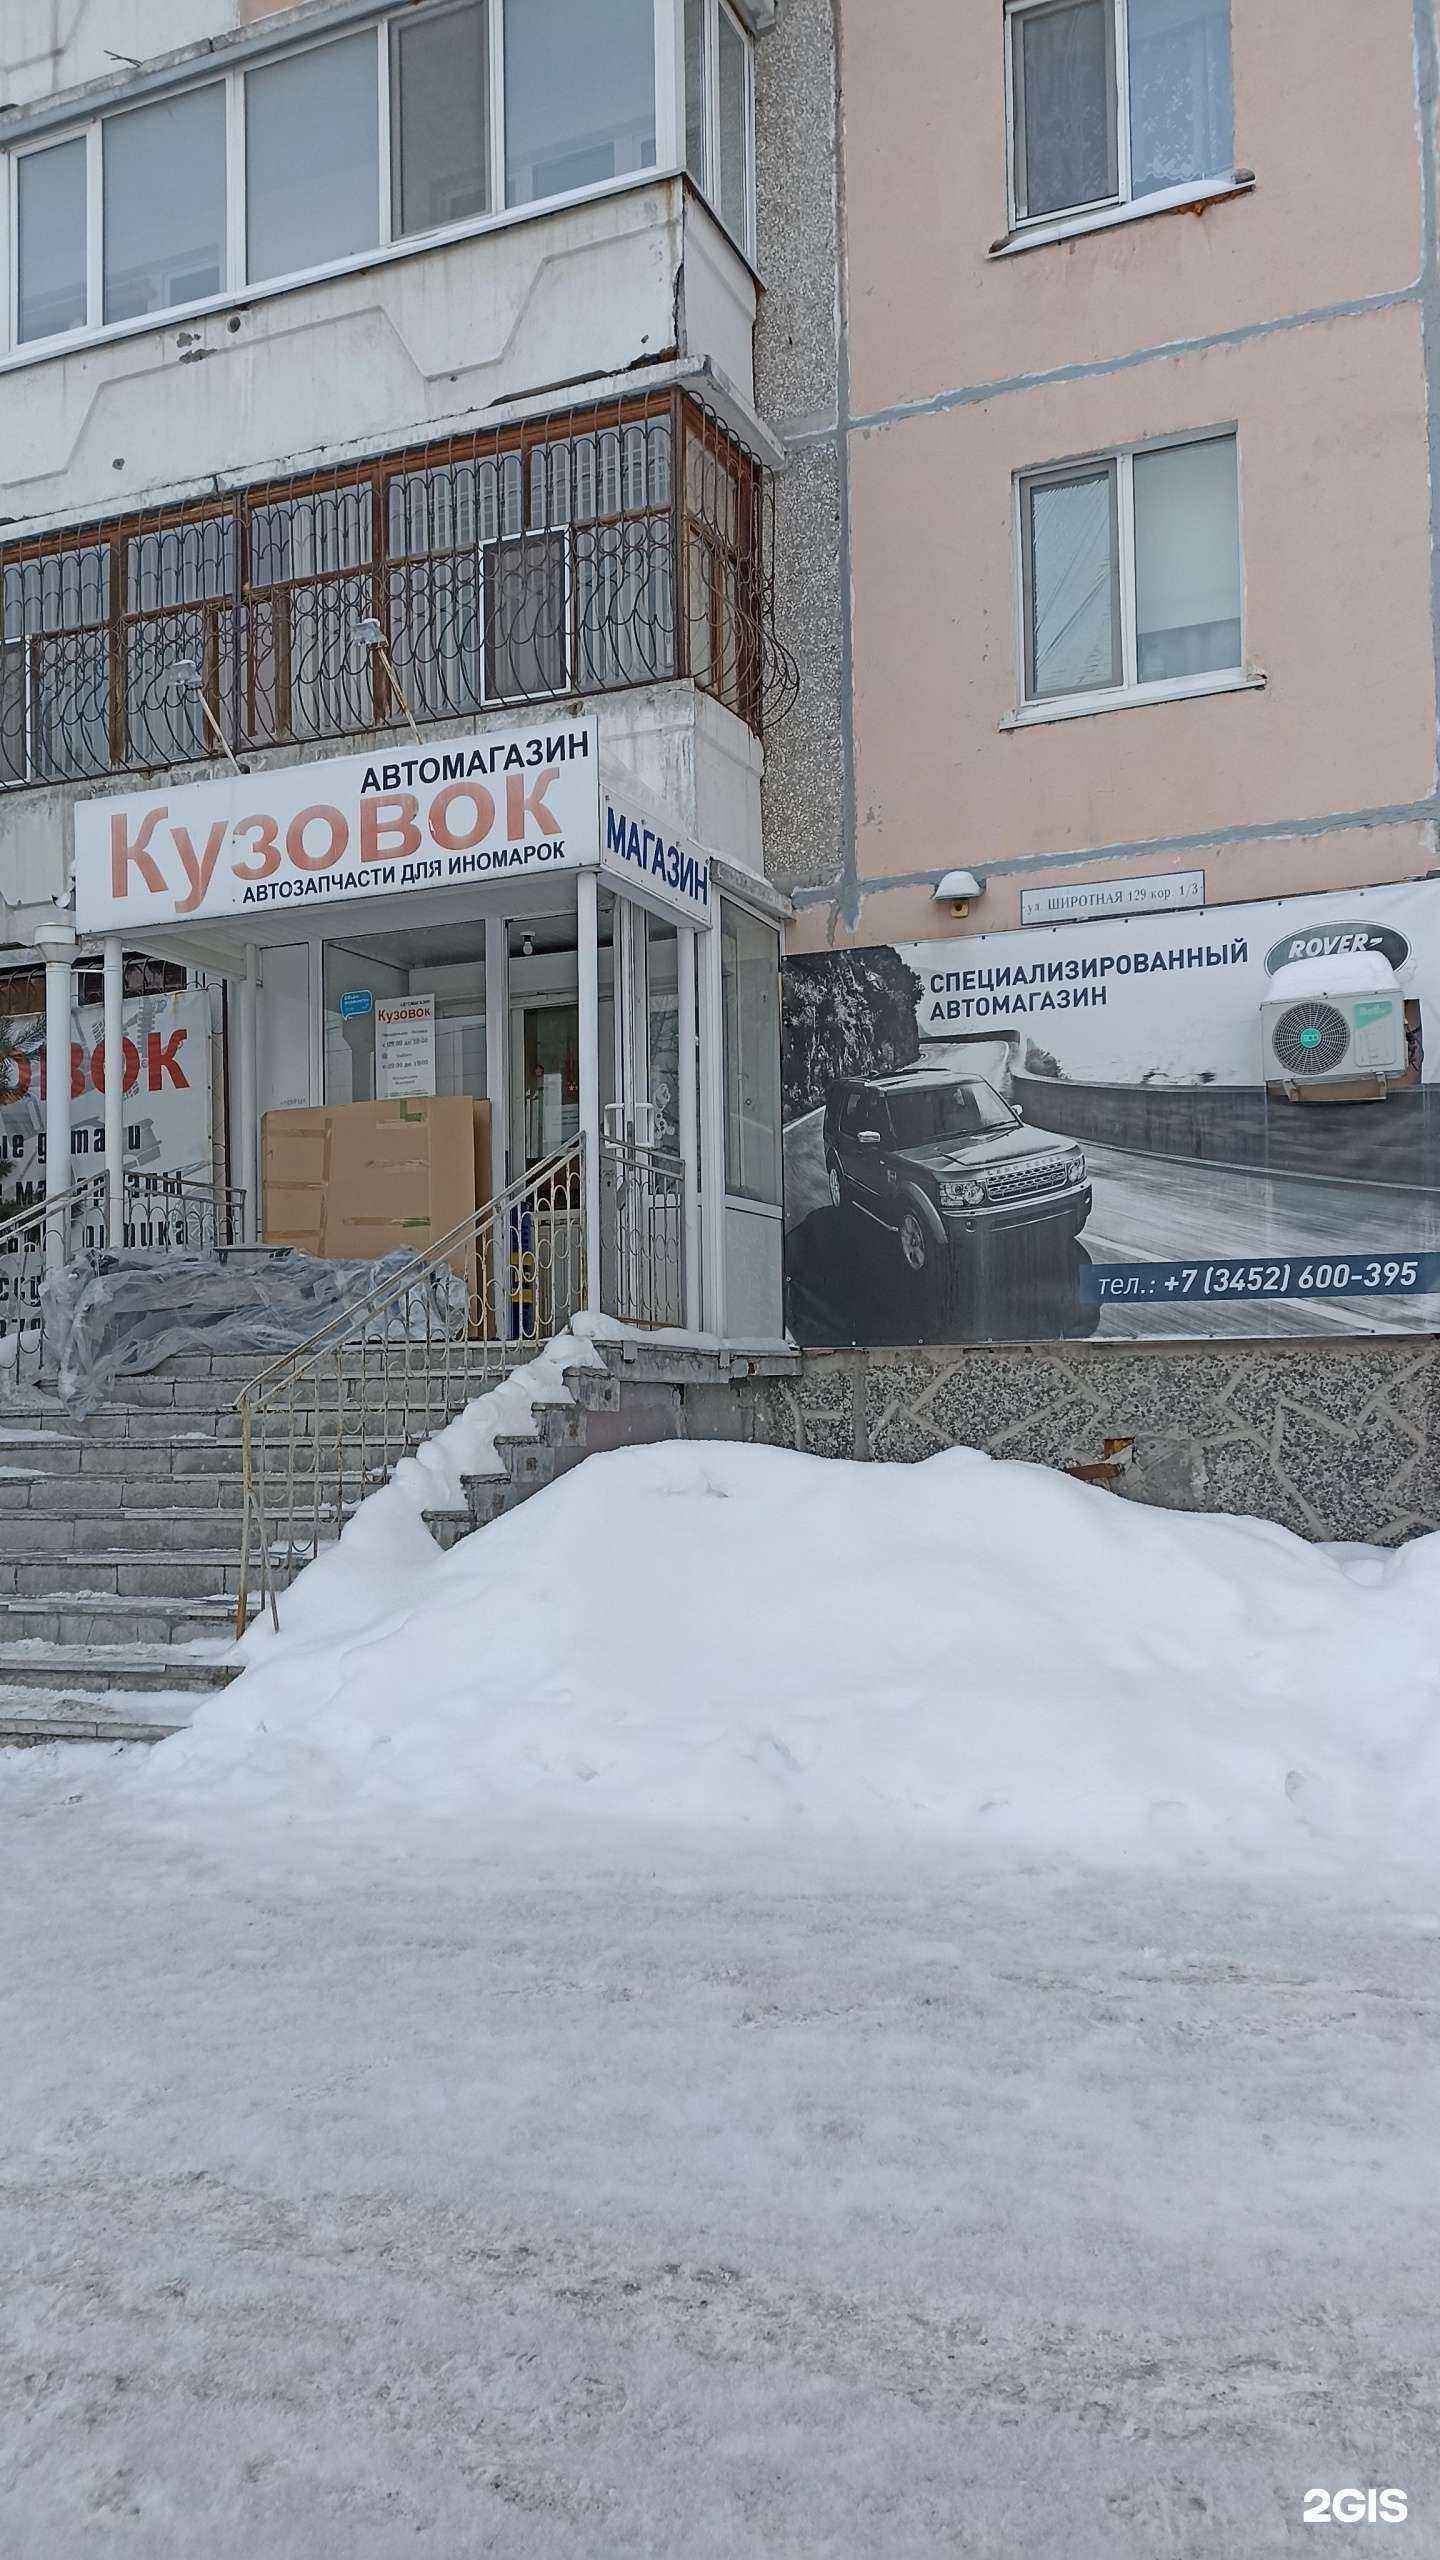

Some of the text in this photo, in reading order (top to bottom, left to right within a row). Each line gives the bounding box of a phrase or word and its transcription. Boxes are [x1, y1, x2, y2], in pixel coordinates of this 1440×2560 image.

[360, 730, 589, 794] АВТОМАГАЗИН
[242, 840, 566, 904] АВТОЗАПЧАСТИ ДЛЯ ИНОМАРОК
[606, 806, 709, 906] МАГАЗИН
[1048, 890, 1123, 911] ШИРОТНАЯ
[1128, 888, 1147, 902] 129
[1178, 882, 1199, 899] 1/3
[930, 937, 1249, 994] СПЕЦИАЛИЗИРОВАННЫЙ
[929, 986, 1108, 1021] АВТОМАГАЗИН
[1099, 1261, 1418, 1296] тел.: +7 (3452) 600-395
